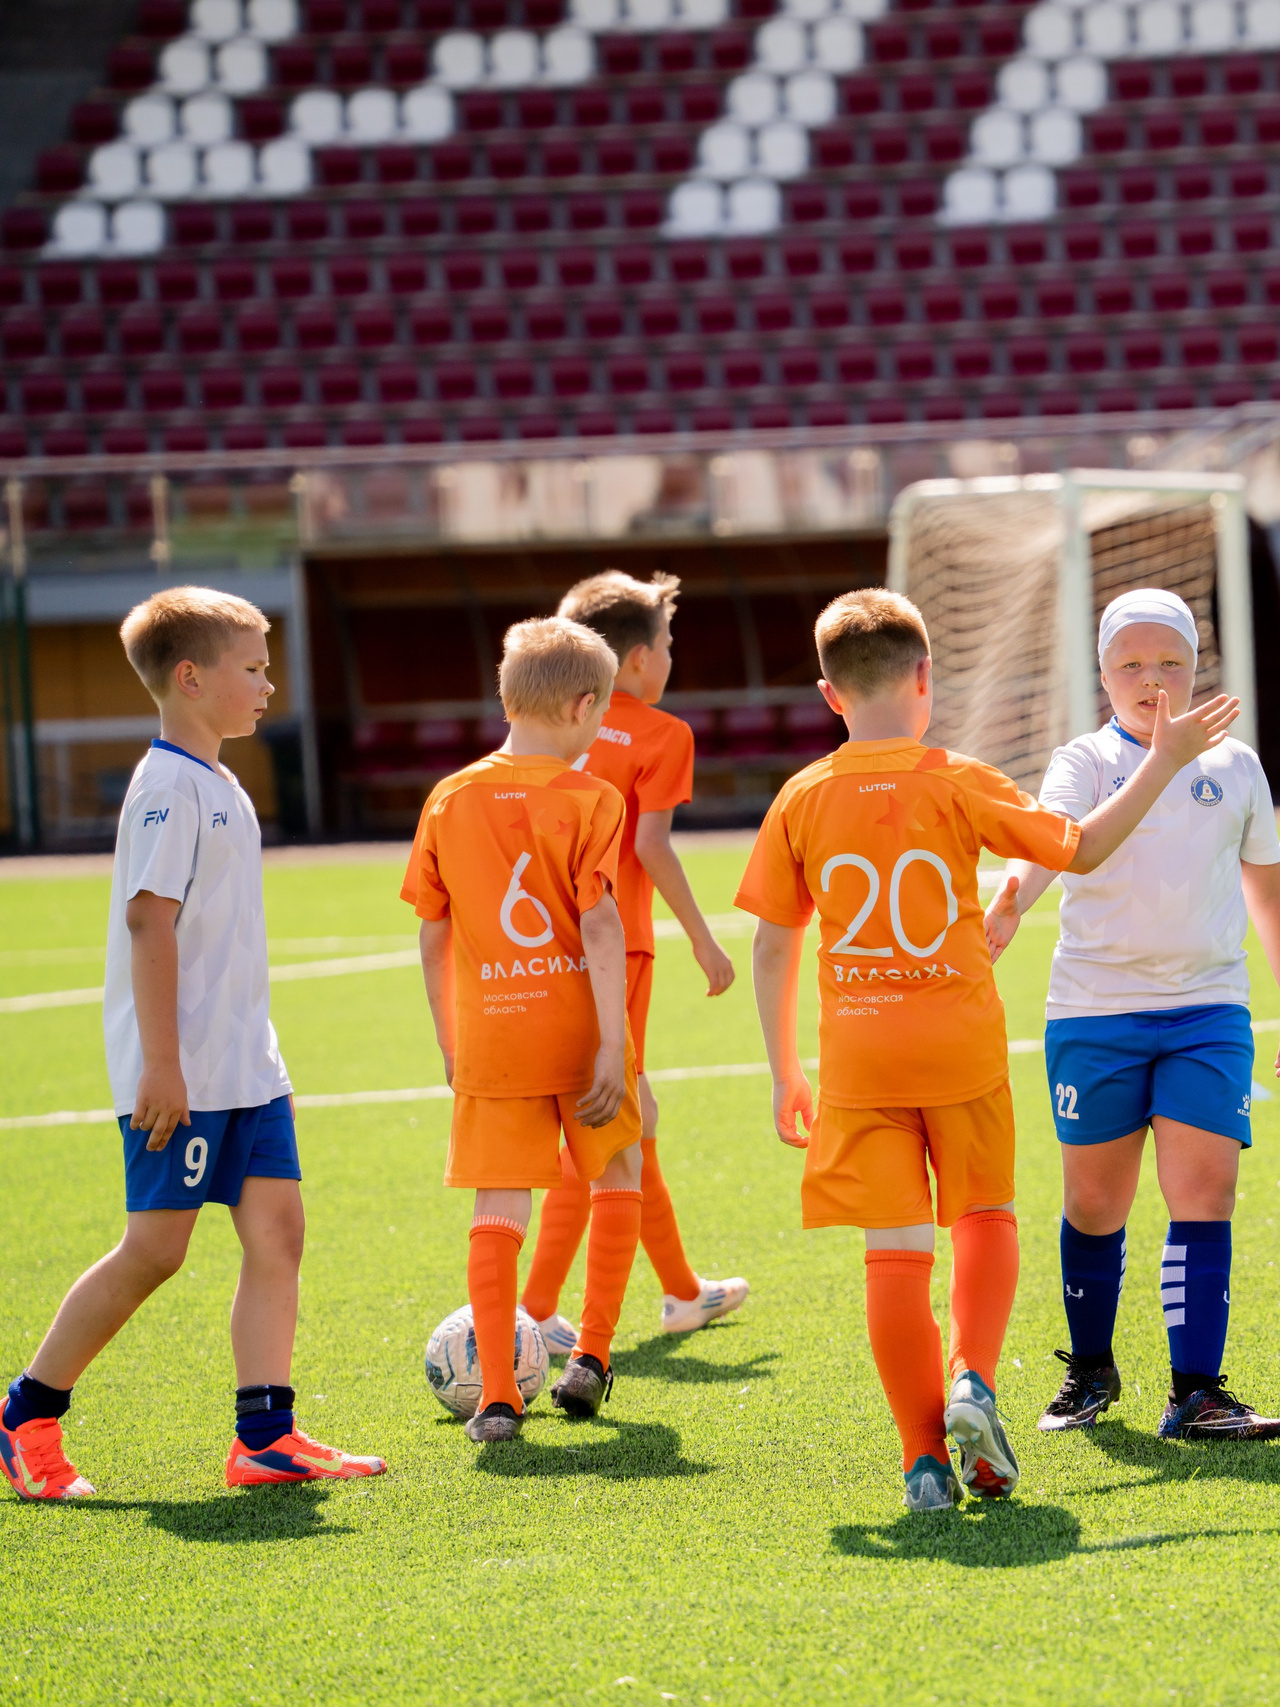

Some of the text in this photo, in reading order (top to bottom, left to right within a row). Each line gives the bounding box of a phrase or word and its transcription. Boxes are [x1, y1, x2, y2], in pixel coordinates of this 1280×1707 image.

[858, 783, 896, 793] LUTCH
[500, 851, 554, 947] 6
[820, 849, 958, 957] 20
[481, 955, 588, 980] ВЛАСИХА
[483, 990, 548, 1003] Московская
[483, 1004, 527, 1016] область
[836, 1006, 879, 1016] область
[1056, 1082, 1080, 1120] 22
[183, 1136, 209, 1188] 9
